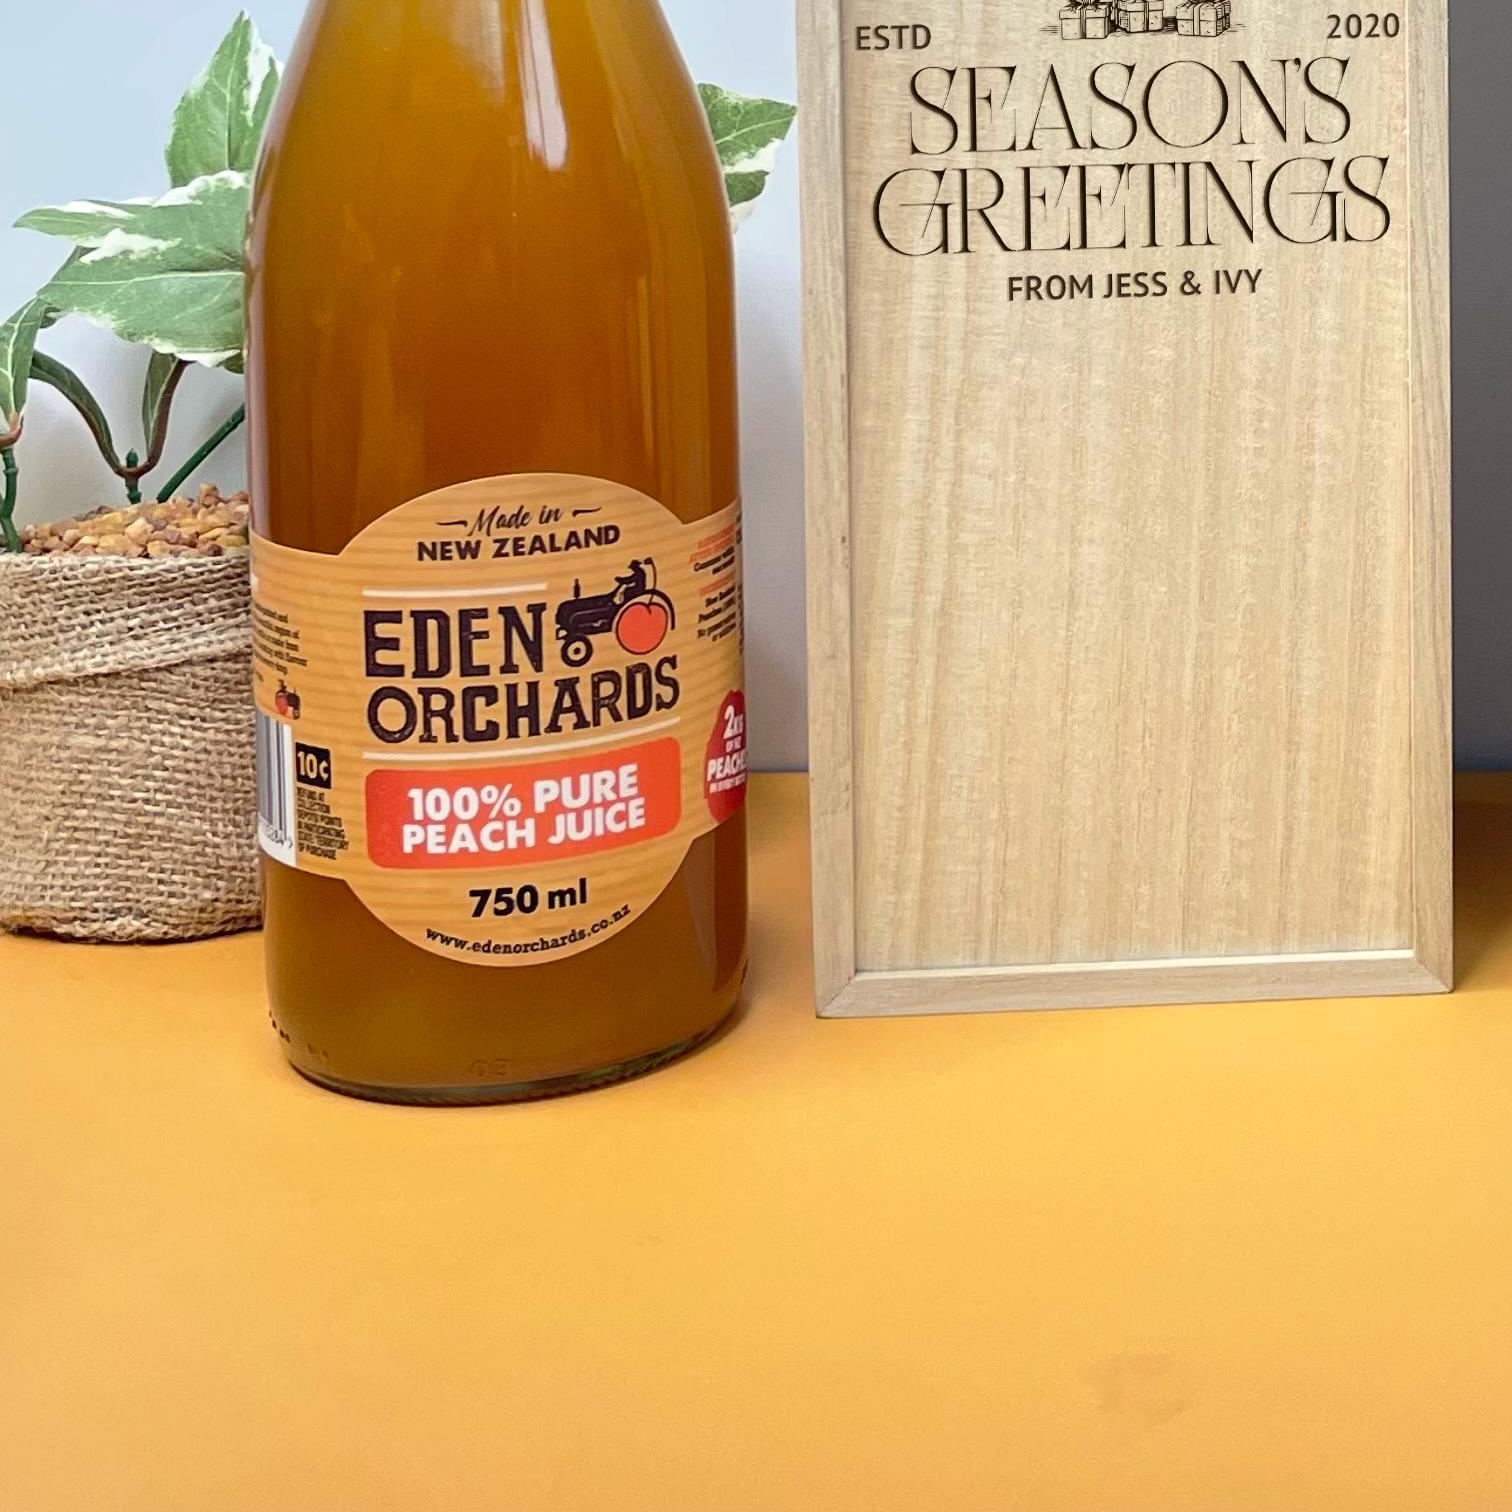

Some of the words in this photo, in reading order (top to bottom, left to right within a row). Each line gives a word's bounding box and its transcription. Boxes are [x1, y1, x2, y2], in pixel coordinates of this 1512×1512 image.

[855, 23, 932, 50] ESTD
[1325, 13, 1401, 40] 2020
[908, 56, 1352, 156] SEASON'S
[872, 154, 1391, 256] GREETINGS
[1007, 273, 1094, 301] FROM
[1102, 270, 1168, 299] JESS
[1179, 270, 1202, 297] &
[1212, 268, 1263, 294] IVY
[417, 540, 482, 561] NEW
[492, 524, 621, 559] ZEALAND
[467, 505, 532, 537] Made
[538, 505, 563, 524] in
[363, 602, 547, 679] EDEN
[367, 655, 681, 744] ORCHARDS
[407, 784, 522, 821] 100%
[534, 763, 638, 814] PURE
[402, 817, 536, 854] PEACH
[547, 797, 646, 844] JUICE
[468, 884, 539, 918] 750
[548, 877, 587, 909] ml
[426, 904, 632, 955] www.edenorchards.co.nz
